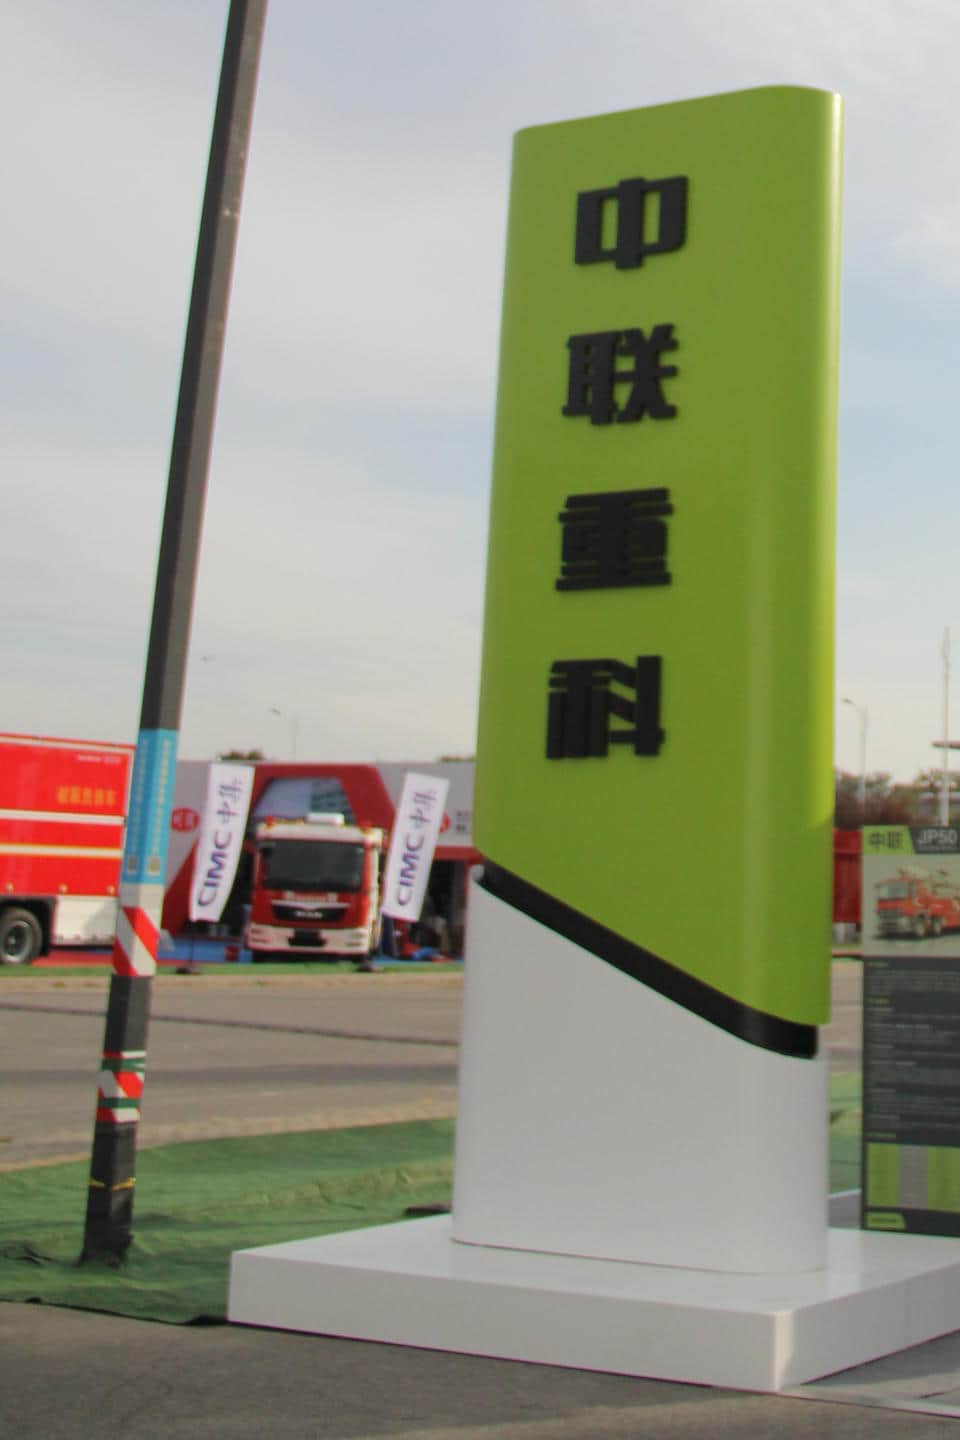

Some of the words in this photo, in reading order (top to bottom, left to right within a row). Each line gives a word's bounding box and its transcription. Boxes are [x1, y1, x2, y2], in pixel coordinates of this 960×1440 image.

[545, 175, 690, 761] 中联重科
[198, 831, 233, 907] CIMC
[397, 831, 425, 906] CIMC
